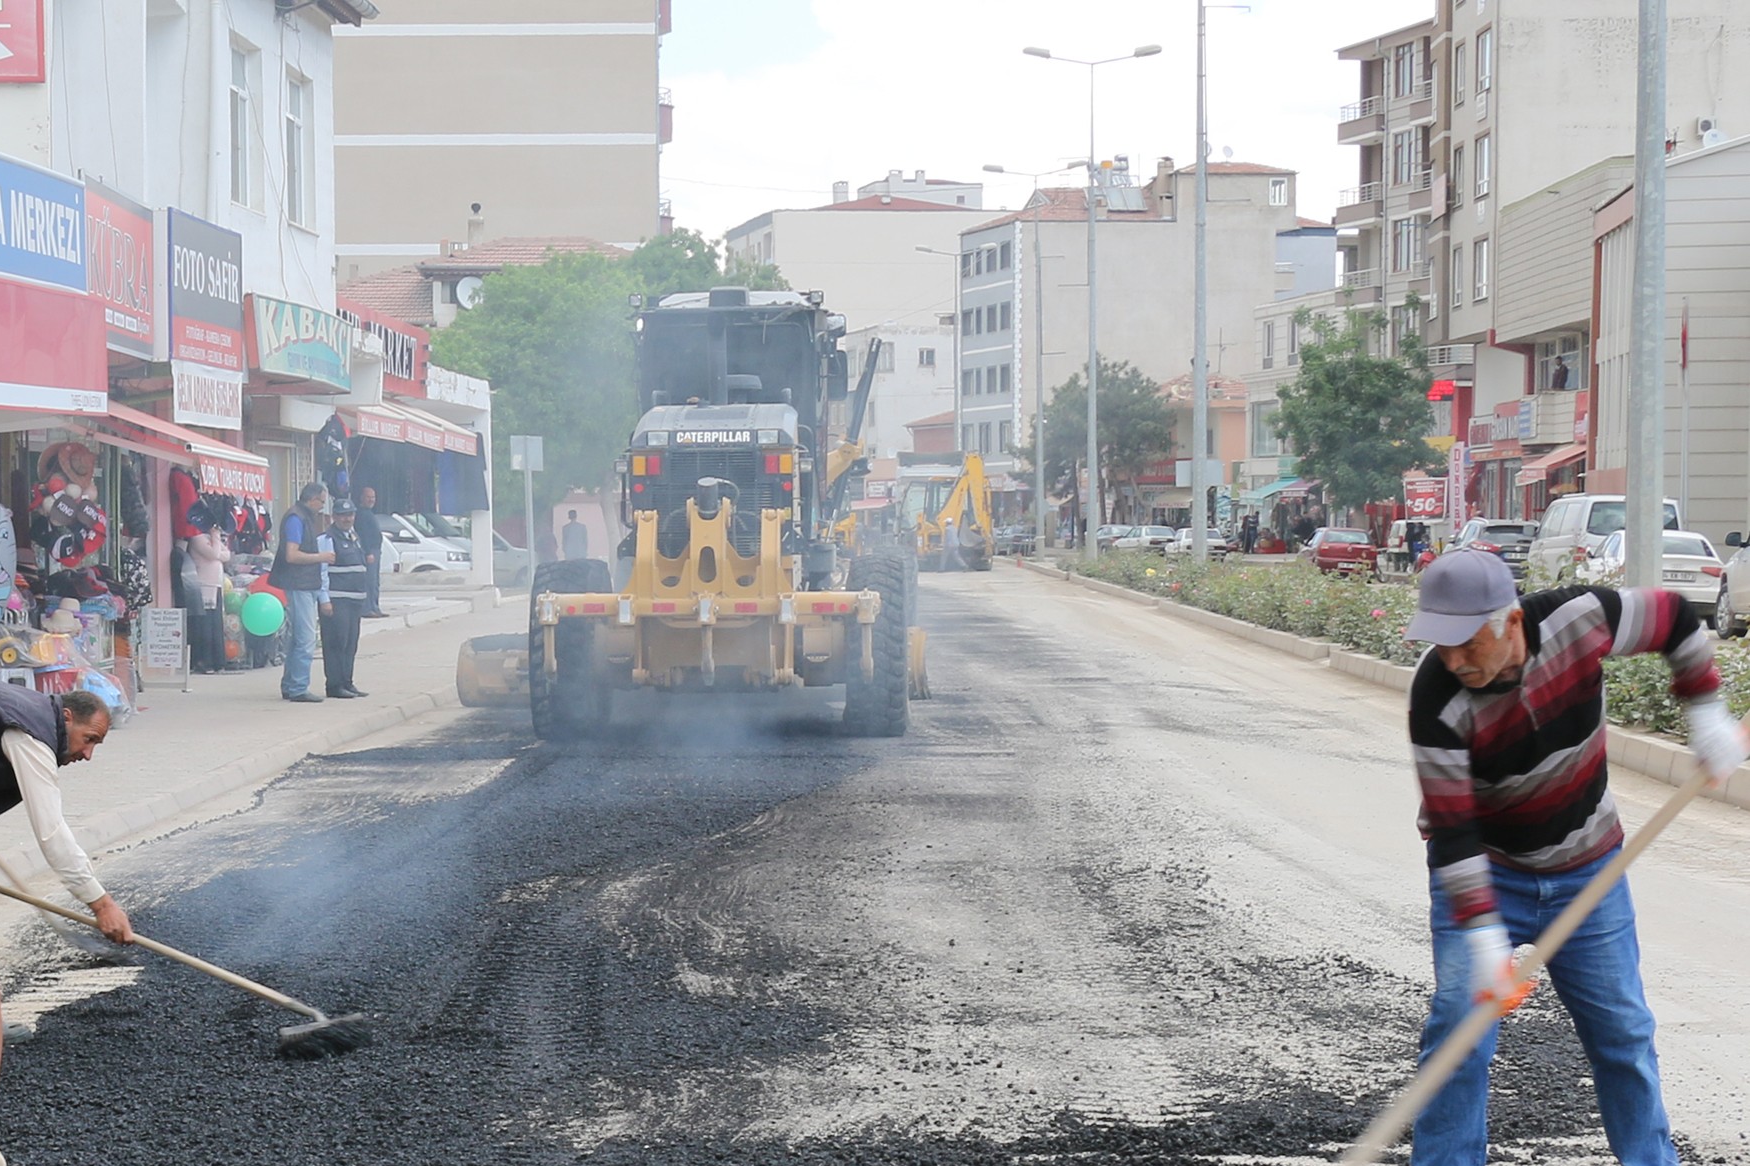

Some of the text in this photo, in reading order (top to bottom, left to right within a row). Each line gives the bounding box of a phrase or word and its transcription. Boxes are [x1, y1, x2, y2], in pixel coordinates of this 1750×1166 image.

[10, 193, 81, 265] MERKEZİ
[87, 205, 151, 316] KÜBRA
[173, 244, 240, 304] FOTO SAFİR
[370, 321, 418, 381] ARKET
[676, 430, 751, 444] CATERPILLAR
[56, 501, 75, 517] KING
[1453, 448, 1462, 534] DONDURM
